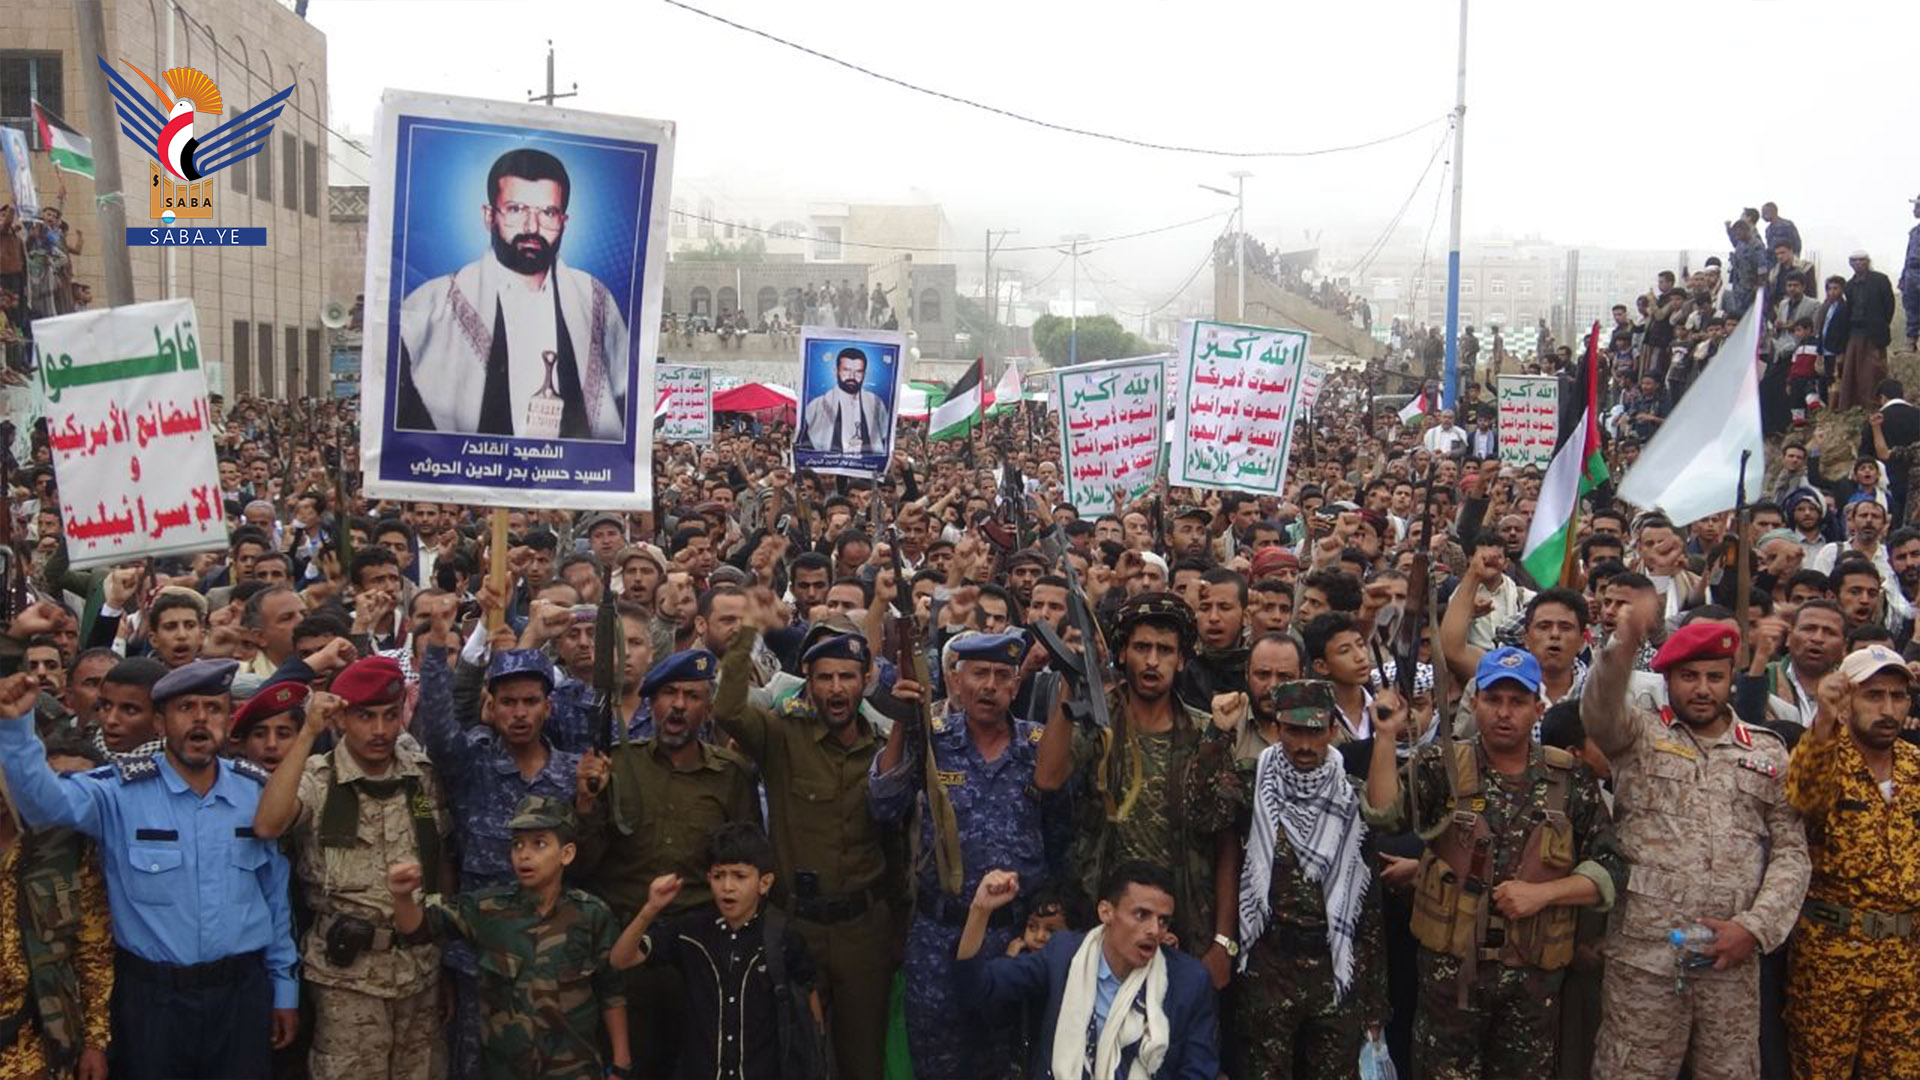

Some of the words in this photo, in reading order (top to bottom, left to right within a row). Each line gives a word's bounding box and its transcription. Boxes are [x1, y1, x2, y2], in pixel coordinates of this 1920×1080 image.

[1198, 331, 1261, 366] أكبر
[1260, 339, 1299, 365] الله
[35, 321, 200, 404] قاطعوا
[1069, 372, 1121, 411] أكبر
[1124, 373, 1159, 396] الله
[1247, 374, 1292, 396] الموت
[1501, 381, 1535, 401] أكبر
[1536, 384, 1557, 399] الله
[1119, 403, 1158, 424] الموت
[1243, 403, 1287, 421] الموت
[48, 400, 131, 459] الأمريكية
[136, 397, 210, 449] البضائع
[1121, 426, 1157, 449] الموت
[1189, 425, 1222, 445] اليهود
[1223, 426, 1243, 446] على
[1247, 426, 1282, 448] اللعنة
[513, 443, 563, 460] الشهيد
[130, 456, 142, 482] و
[410, 457, 461, 477] الحوثي
[465, 462, 502, 479] الدين
[505, 464, 528, 481] بدر
[531, 466, 570, 483] حسين
[1073, 460, 1108, 481] اليهود
[1234, 451, 1277, 478] النصر
[574, 468, 611, 485] السيد
[64, 484, 224, 549] الإسرائيلية
